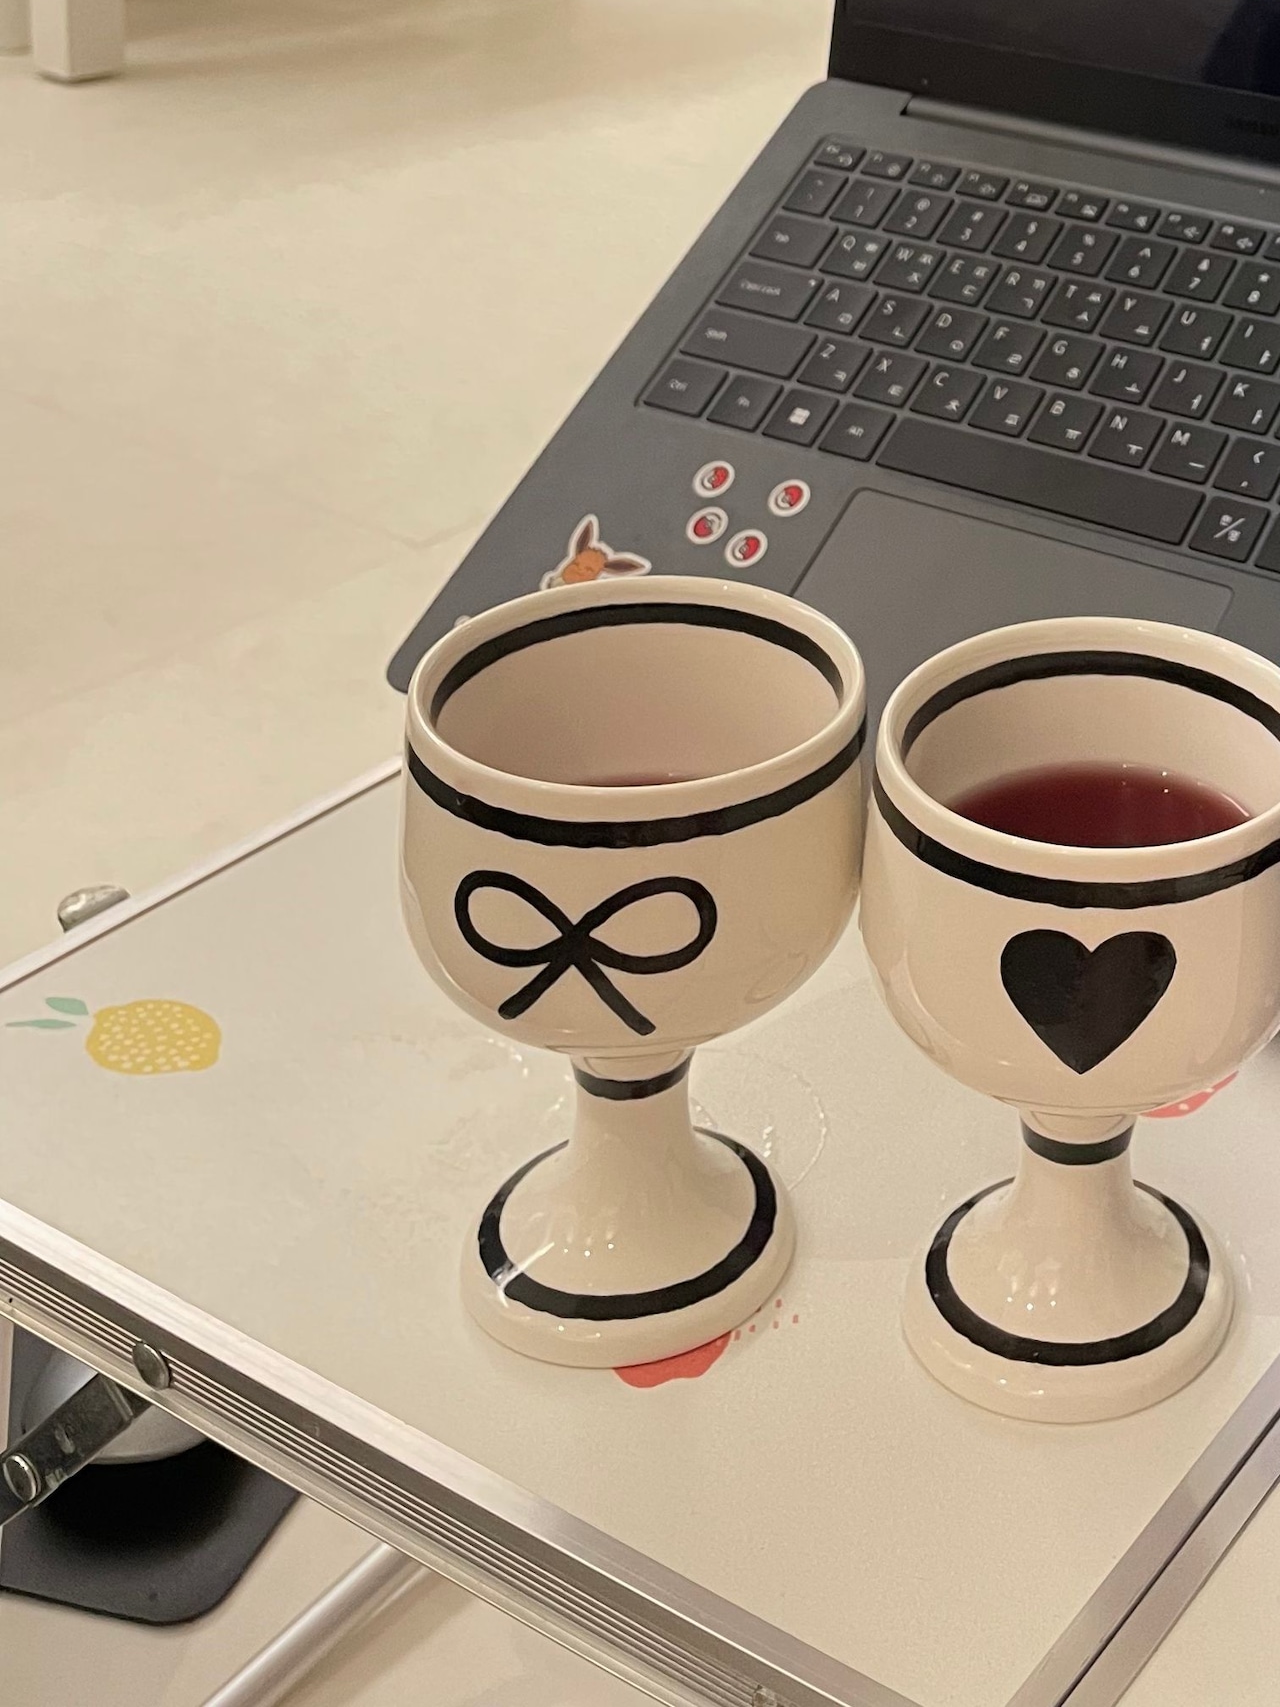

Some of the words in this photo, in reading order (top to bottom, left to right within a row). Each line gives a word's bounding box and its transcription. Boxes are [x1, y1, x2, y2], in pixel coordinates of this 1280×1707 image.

[842, 235, 857, 252] Q
[896, 247, 914, 262] W
[950, 259, 965, 274] E
[1006, 271, 1021, 286] R
[827, 288, 840, 302] A
[882, 300, 896, 315] S
[1124, 297, 1137, 311] Y
[936, 313, 953, 328] D
[1180, 310, 1197, 325] U
[994, 326, 1010, 340] F
[1052, 339, 1068, 355] G
[933, 372, 950, 387] C
[1173, 369, 1187, 383] J
[994, 385, 1009, 400] V
[1233, 382, 1249, 397] K
[1050, 400, 1066, 415] B
[1110, 415, 1128, 431] N
[1171, 429, 1191, 445] M
